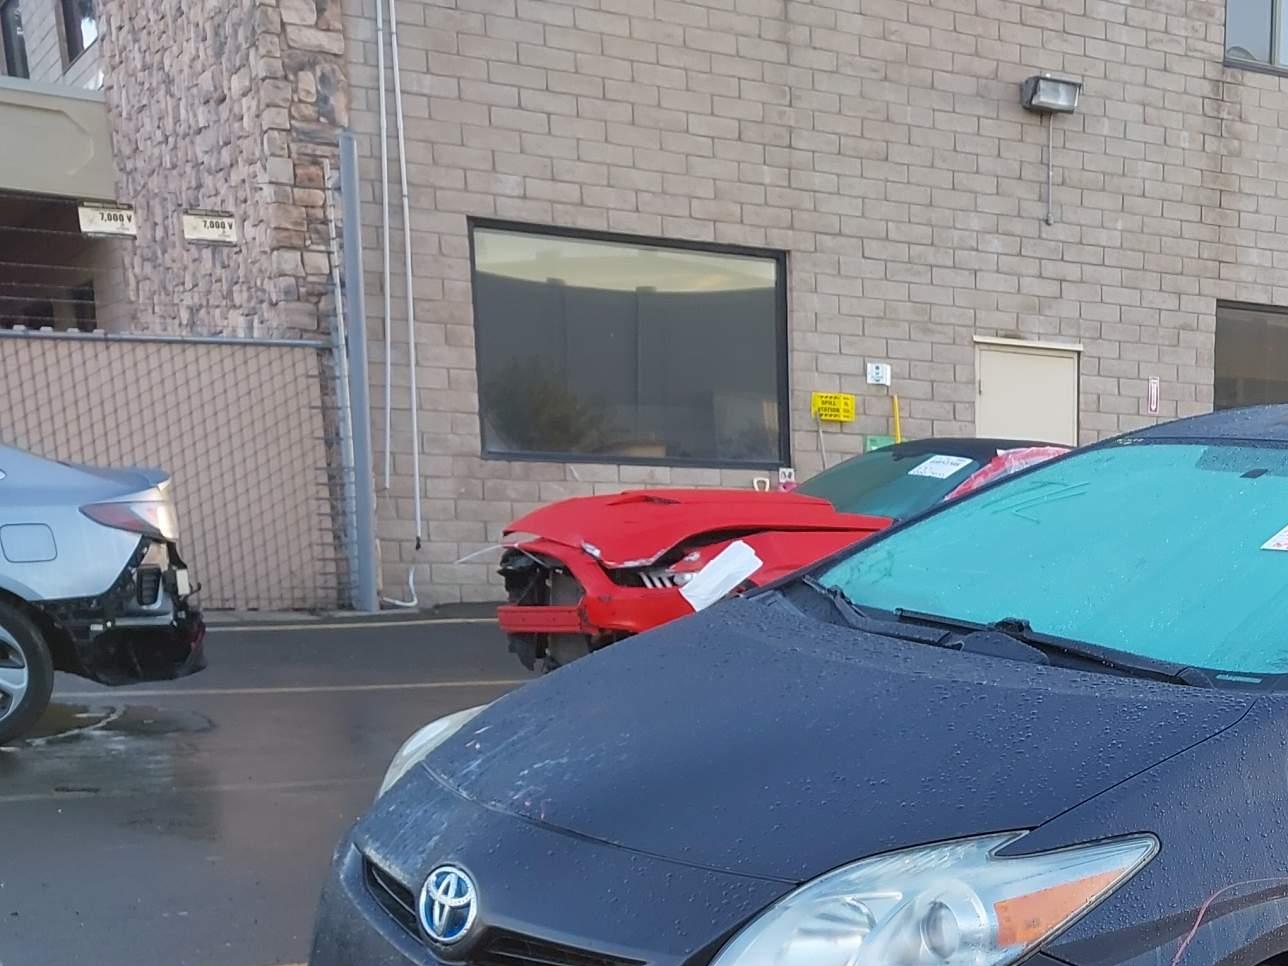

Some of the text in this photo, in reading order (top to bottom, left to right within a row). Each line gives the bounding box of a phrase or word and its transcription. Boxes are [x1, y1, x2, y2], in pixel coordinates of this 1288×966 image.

[100, 212, 132, 223] 7,000 V
[202, 220, 233, 230] 7,000 V
